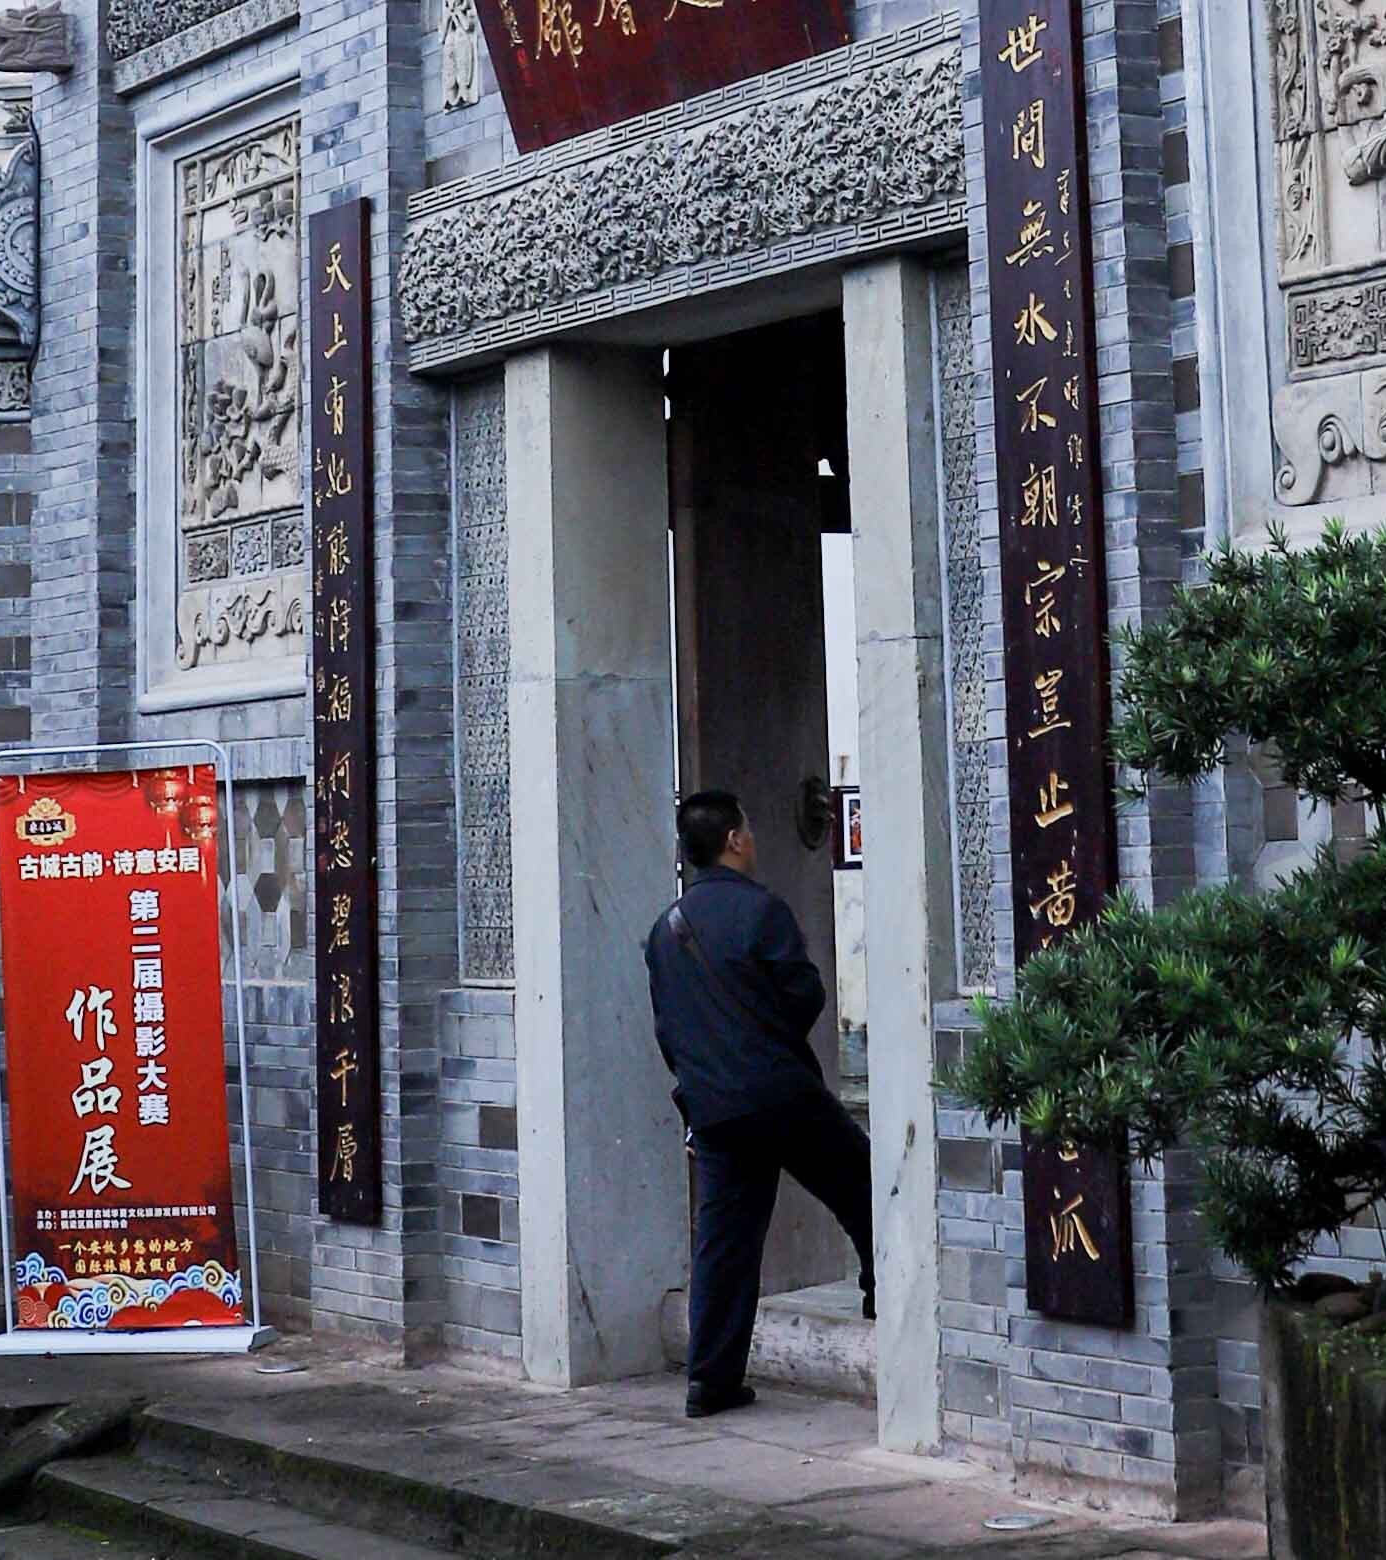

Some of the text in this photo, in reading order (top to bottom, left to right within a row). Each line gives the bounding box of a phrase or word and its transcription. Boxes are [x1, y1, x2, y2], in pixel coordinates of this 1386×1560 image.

[65, 985, 132, 1194] 作品展
[129, 890, 169, 1125] 第二届摄影大赛
